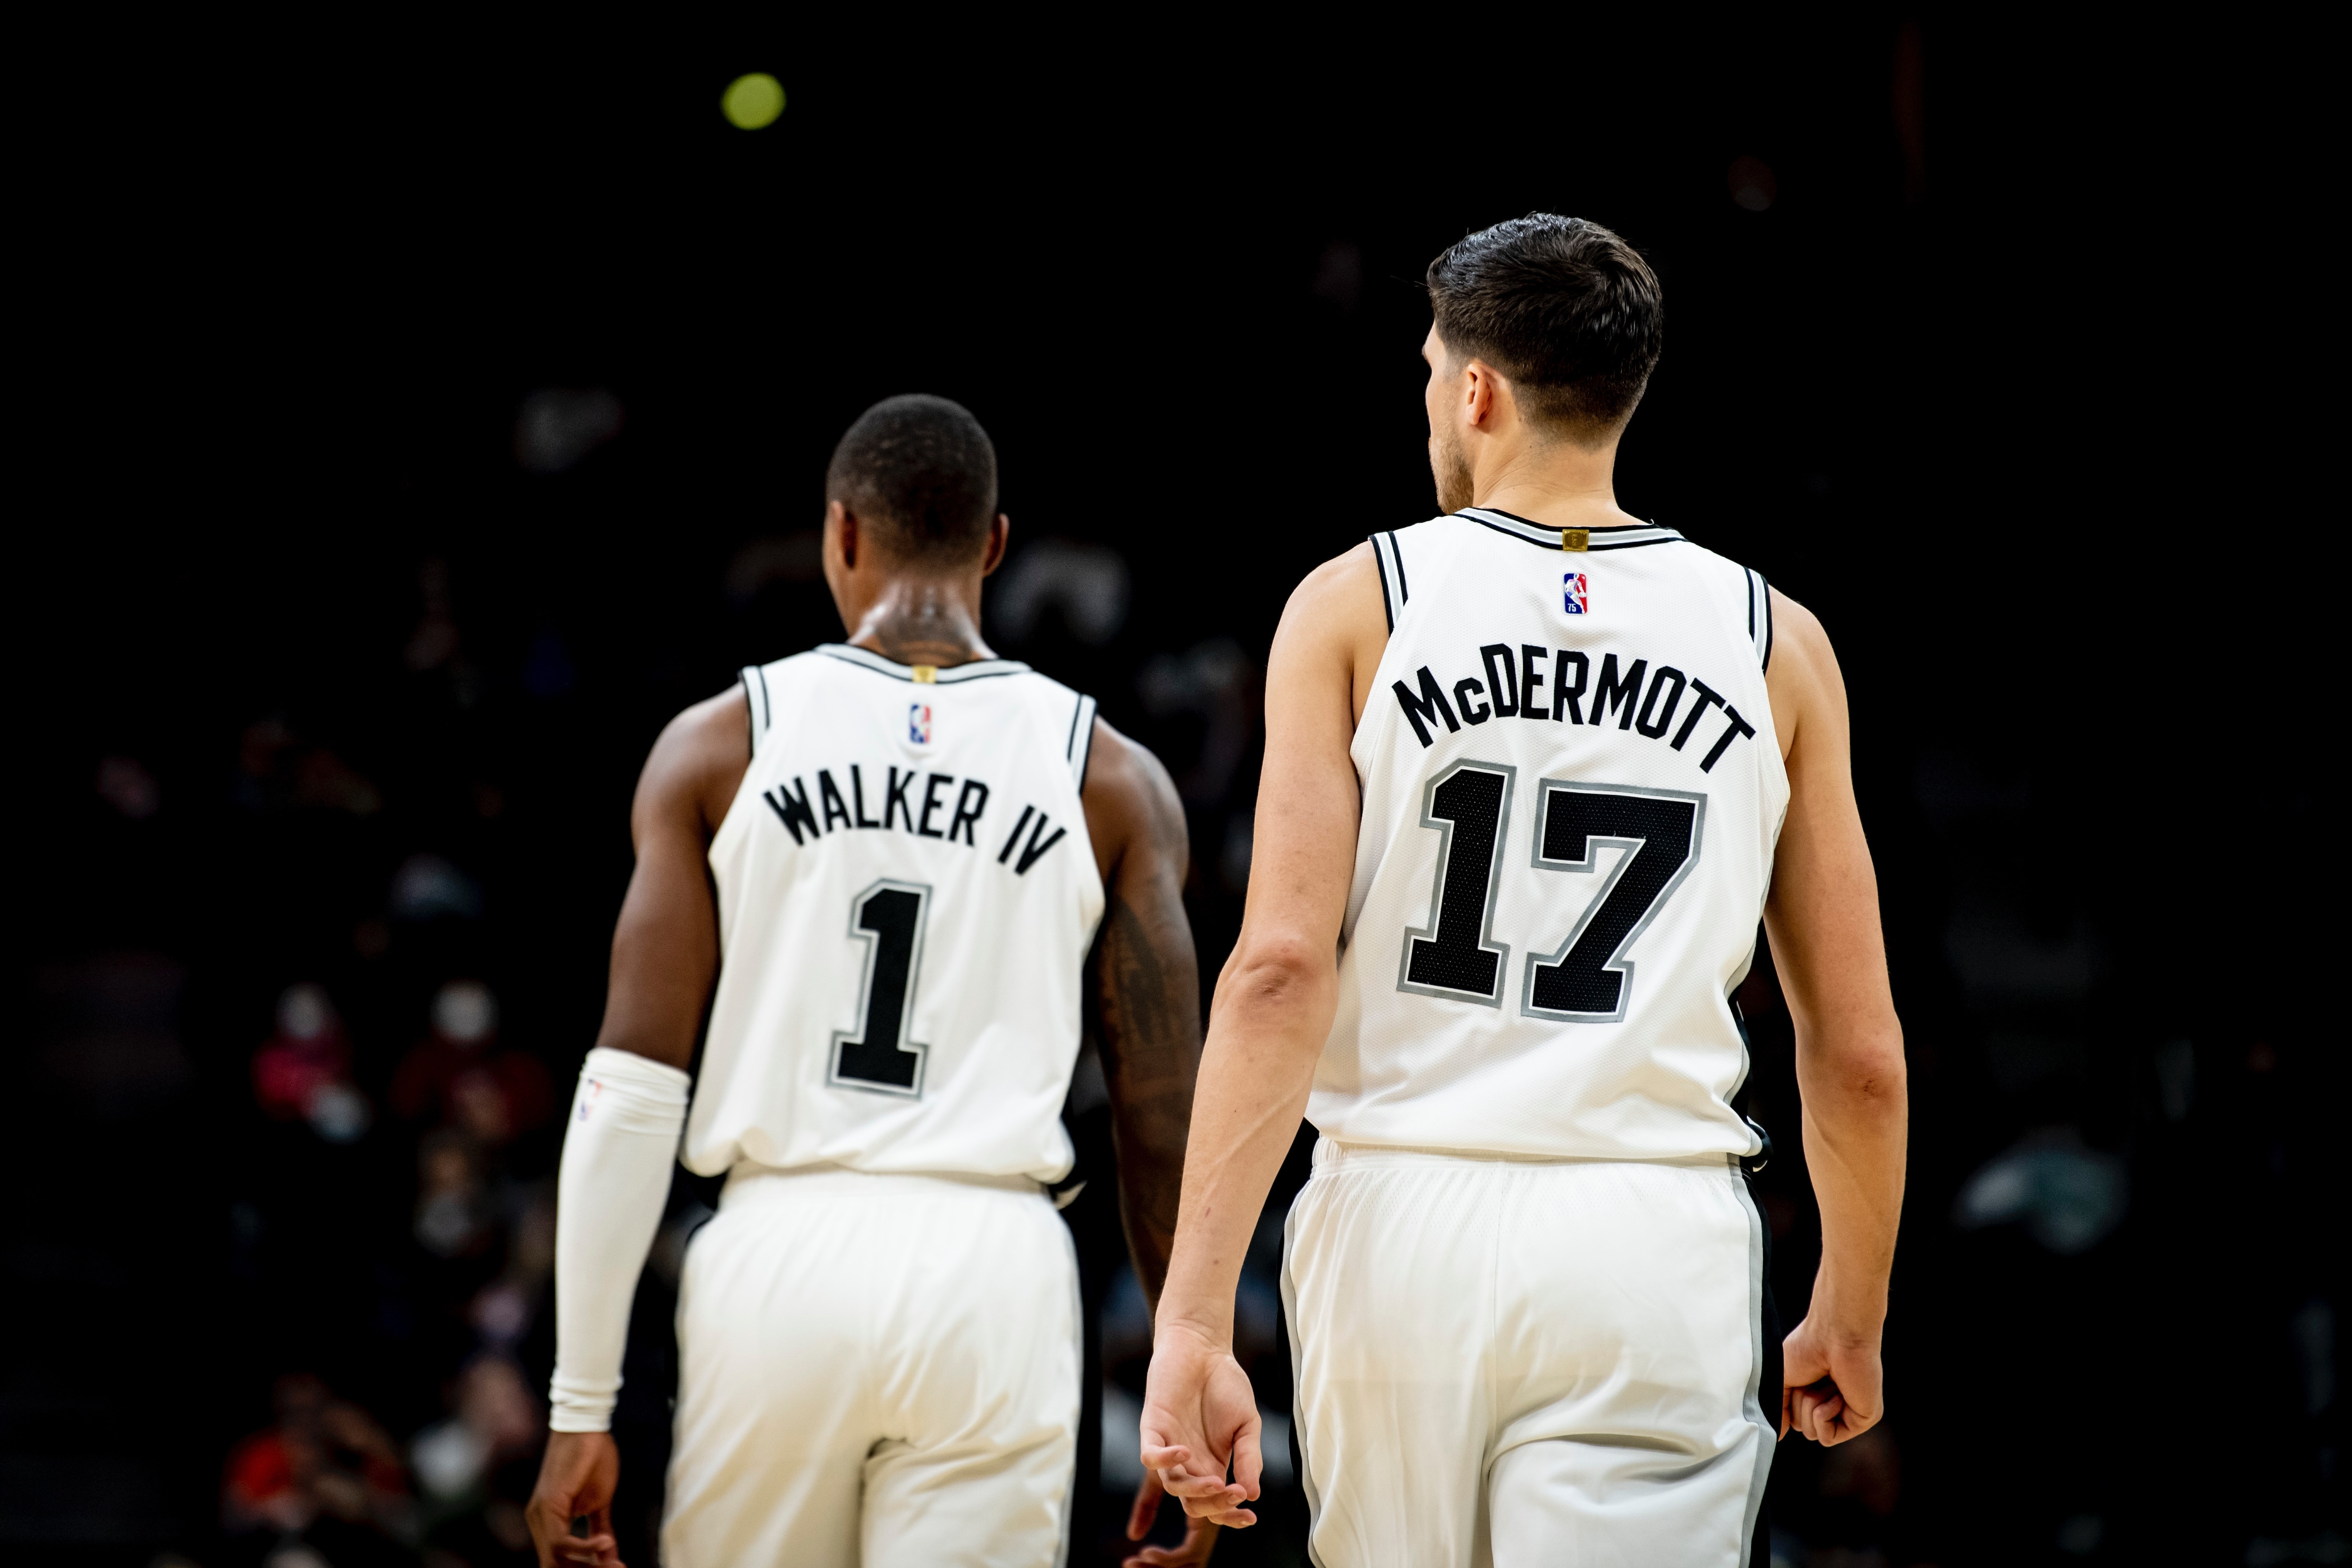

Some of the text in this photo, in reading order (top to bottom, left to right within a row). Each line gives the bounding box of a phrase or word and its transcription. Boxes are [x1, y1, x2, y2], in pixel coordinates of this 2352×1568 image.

[1567, 603, 1576, 612] 75
[1391, 643, 1756, 774] McDERMOTT
[763, 764, 1067, 876] WALKER IV
[1396, 758, 1708, 1023] 17
[825, 877, 933, 1101] 1
